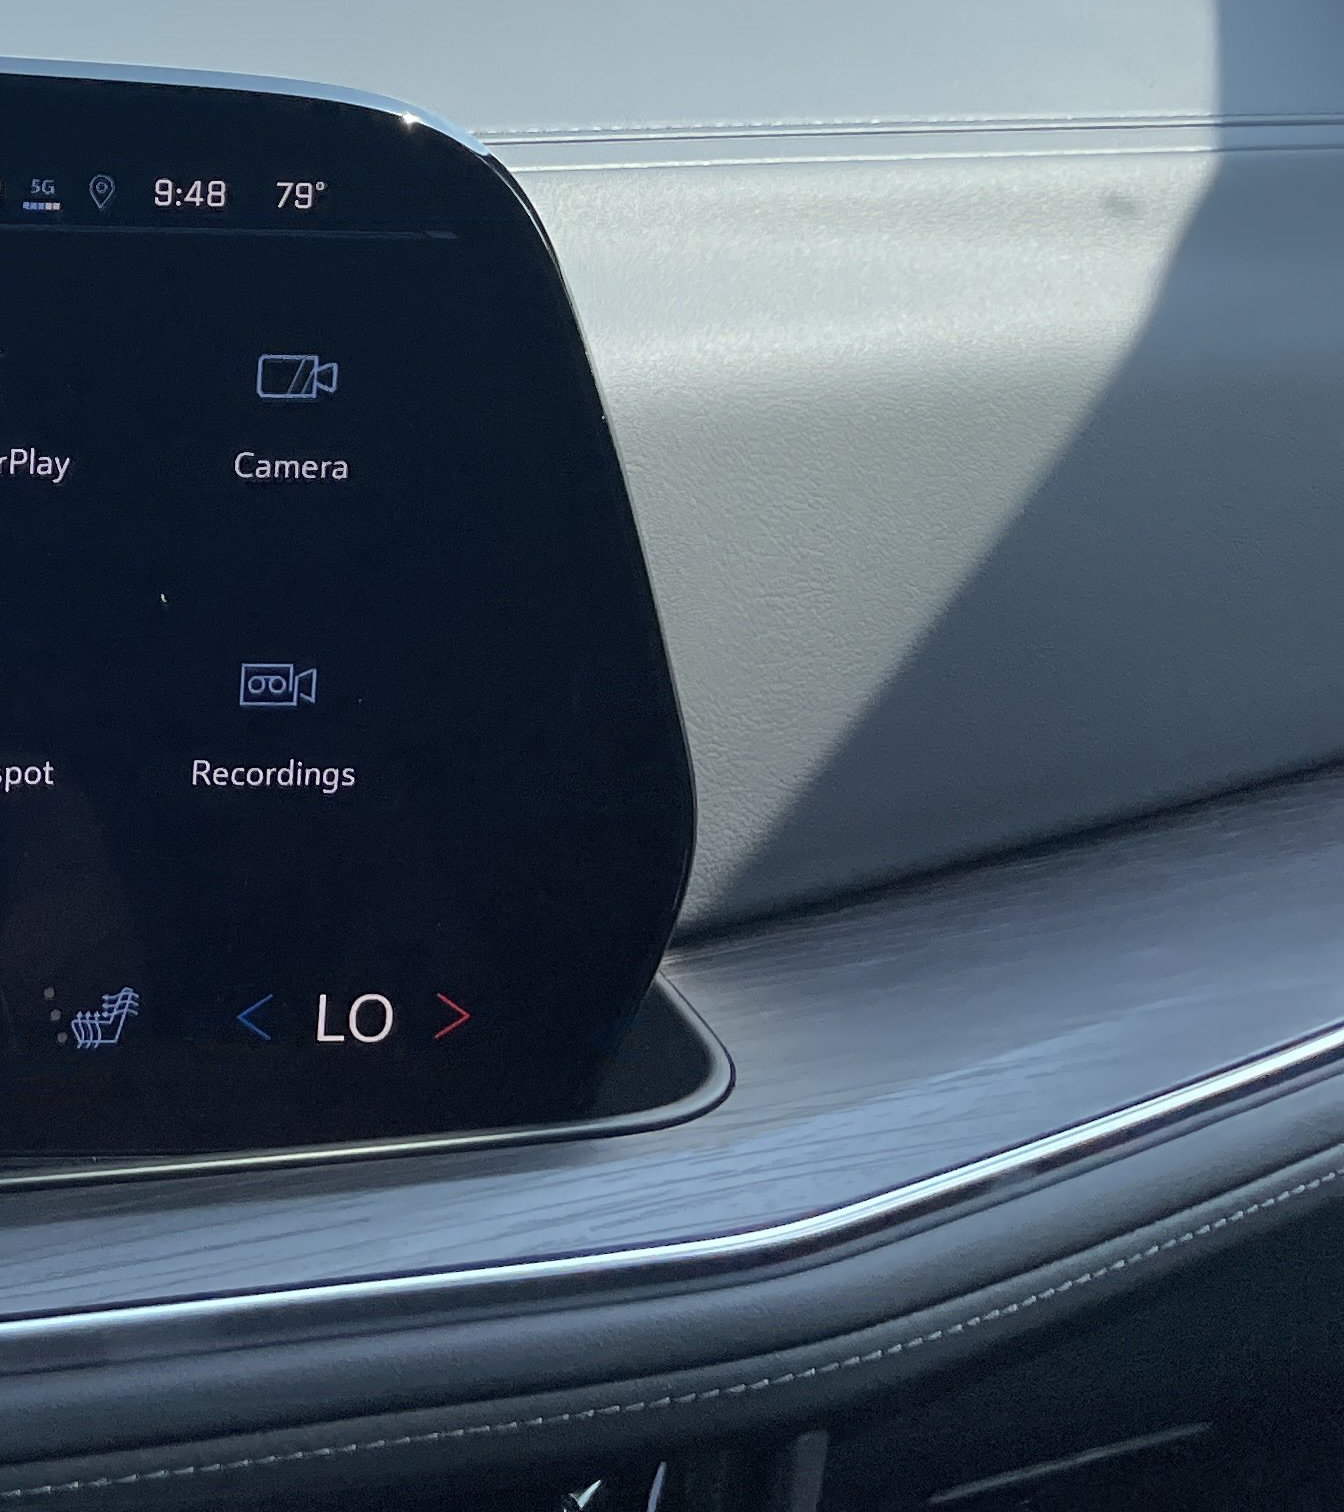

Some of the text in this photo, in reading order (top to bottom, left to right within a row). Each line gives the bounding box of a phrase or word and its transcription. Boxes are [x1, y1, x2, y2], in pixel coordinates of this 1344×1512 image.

[31, 178, 55, 195] 5G
[154, 179, 227, 207] 9:48
[276, 181, 325, 209] 79°
[234, 451, 348, 480] Camera
[192, 758, 355, 794] Recordings
[316, 993, 394, 1043] LO
